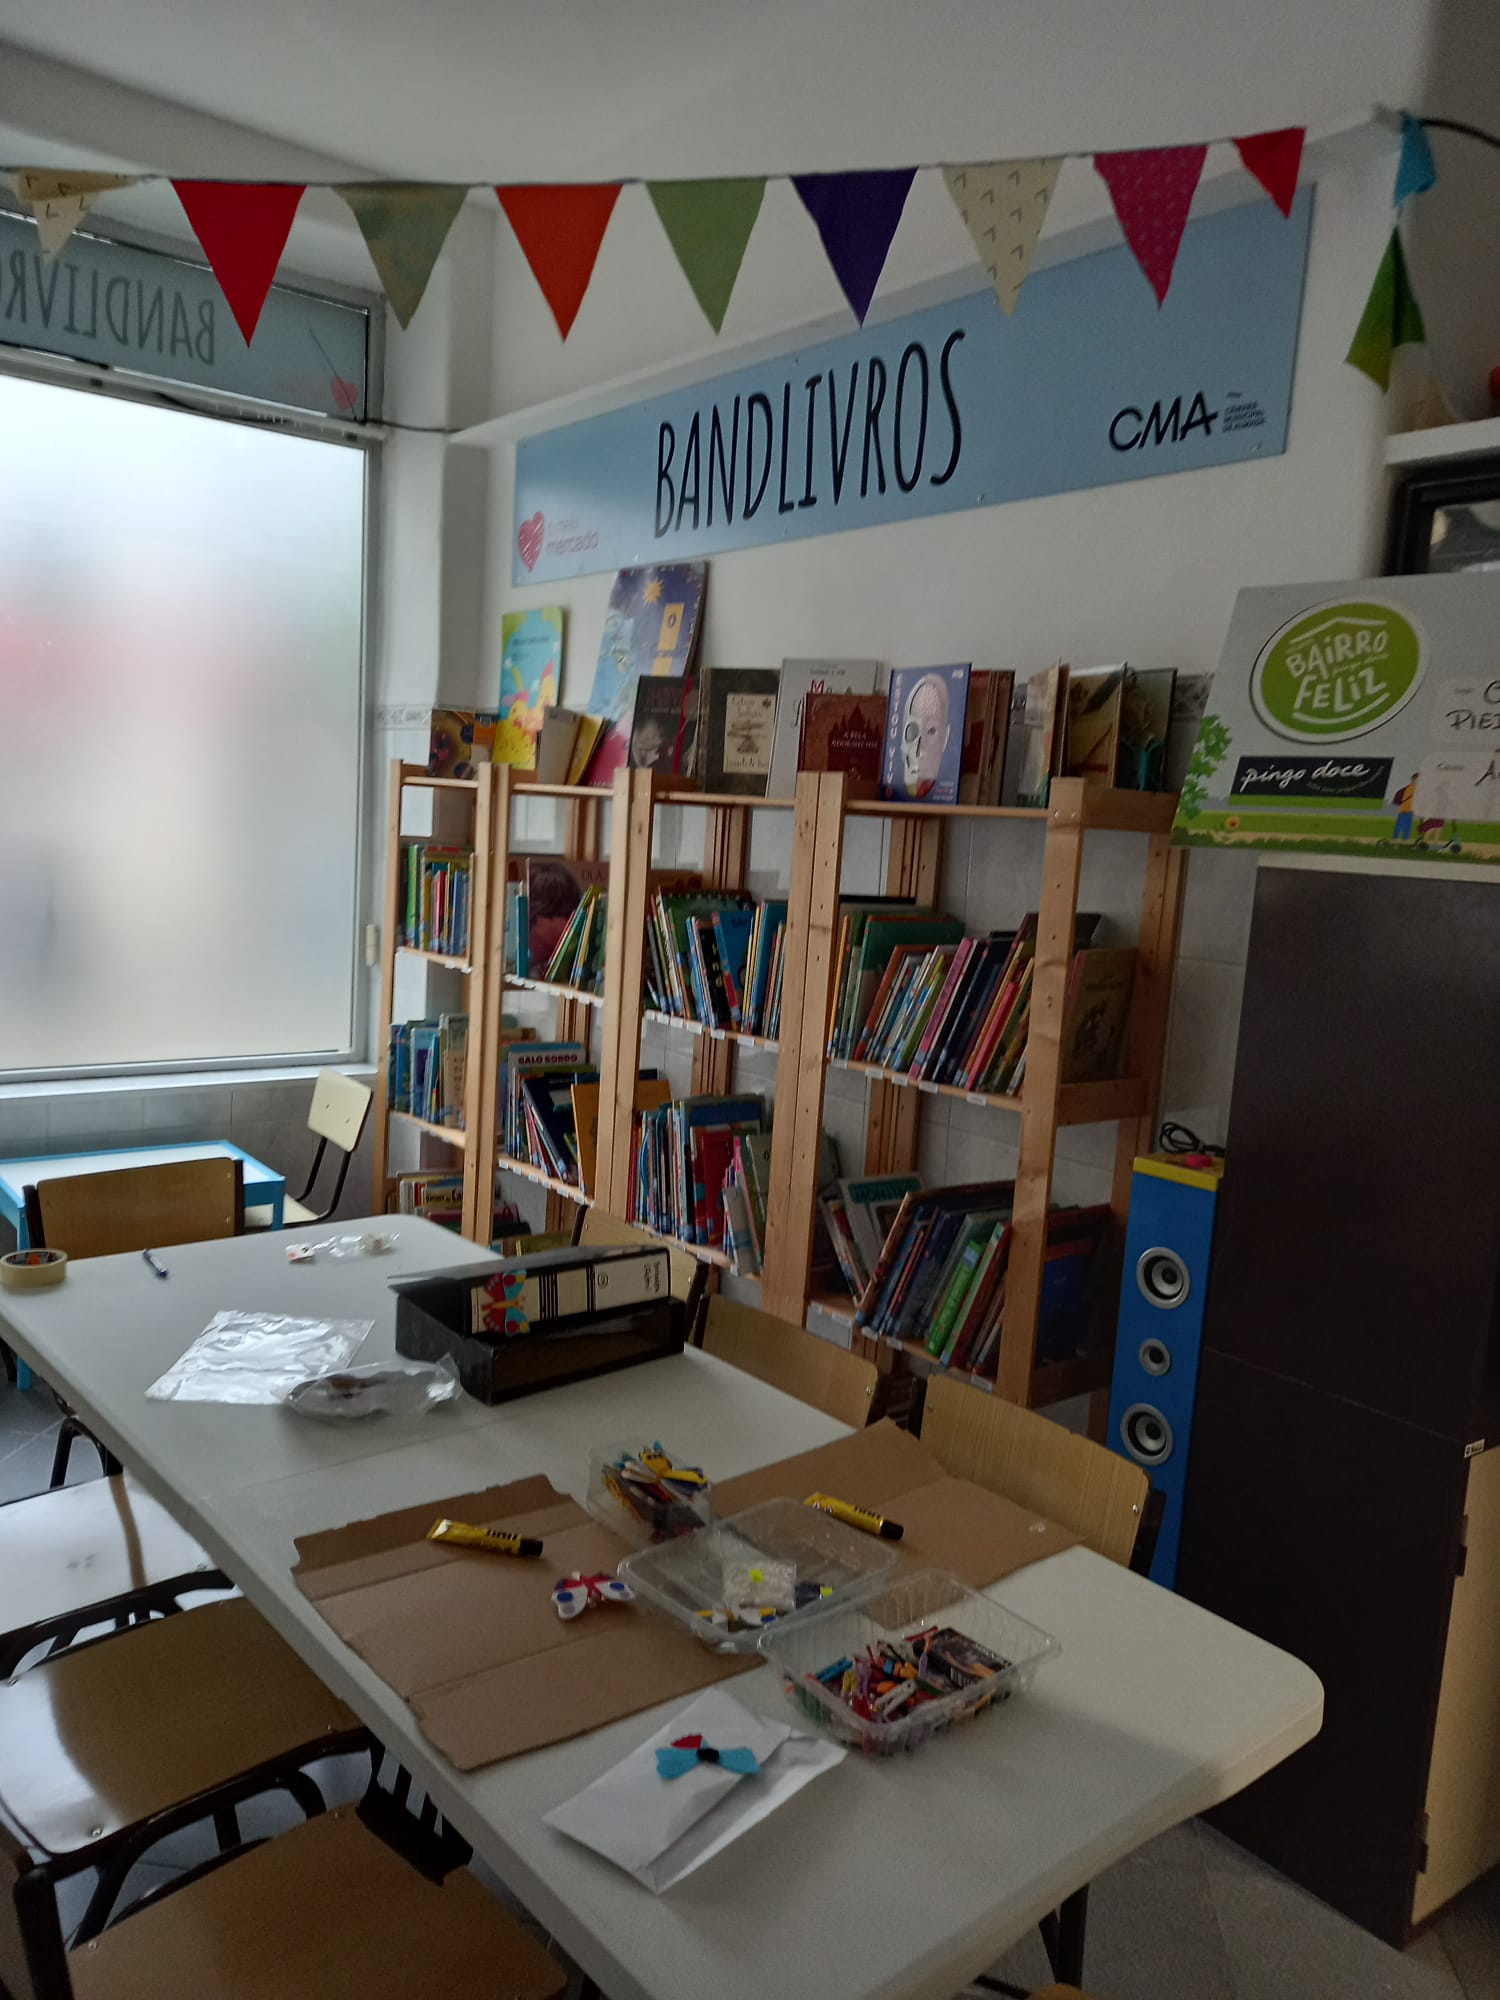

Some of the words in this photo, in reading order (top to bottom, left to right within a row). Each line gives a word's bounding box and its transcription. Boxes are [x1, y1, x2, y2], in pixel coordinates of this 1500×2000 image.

[653, 328, 966, 538] BANDLIVROS
[1109, 389, 1219, 452] CMA
[1240, 764, 1307, 793] pingo
[1311, 759, 1371, 780] doce
